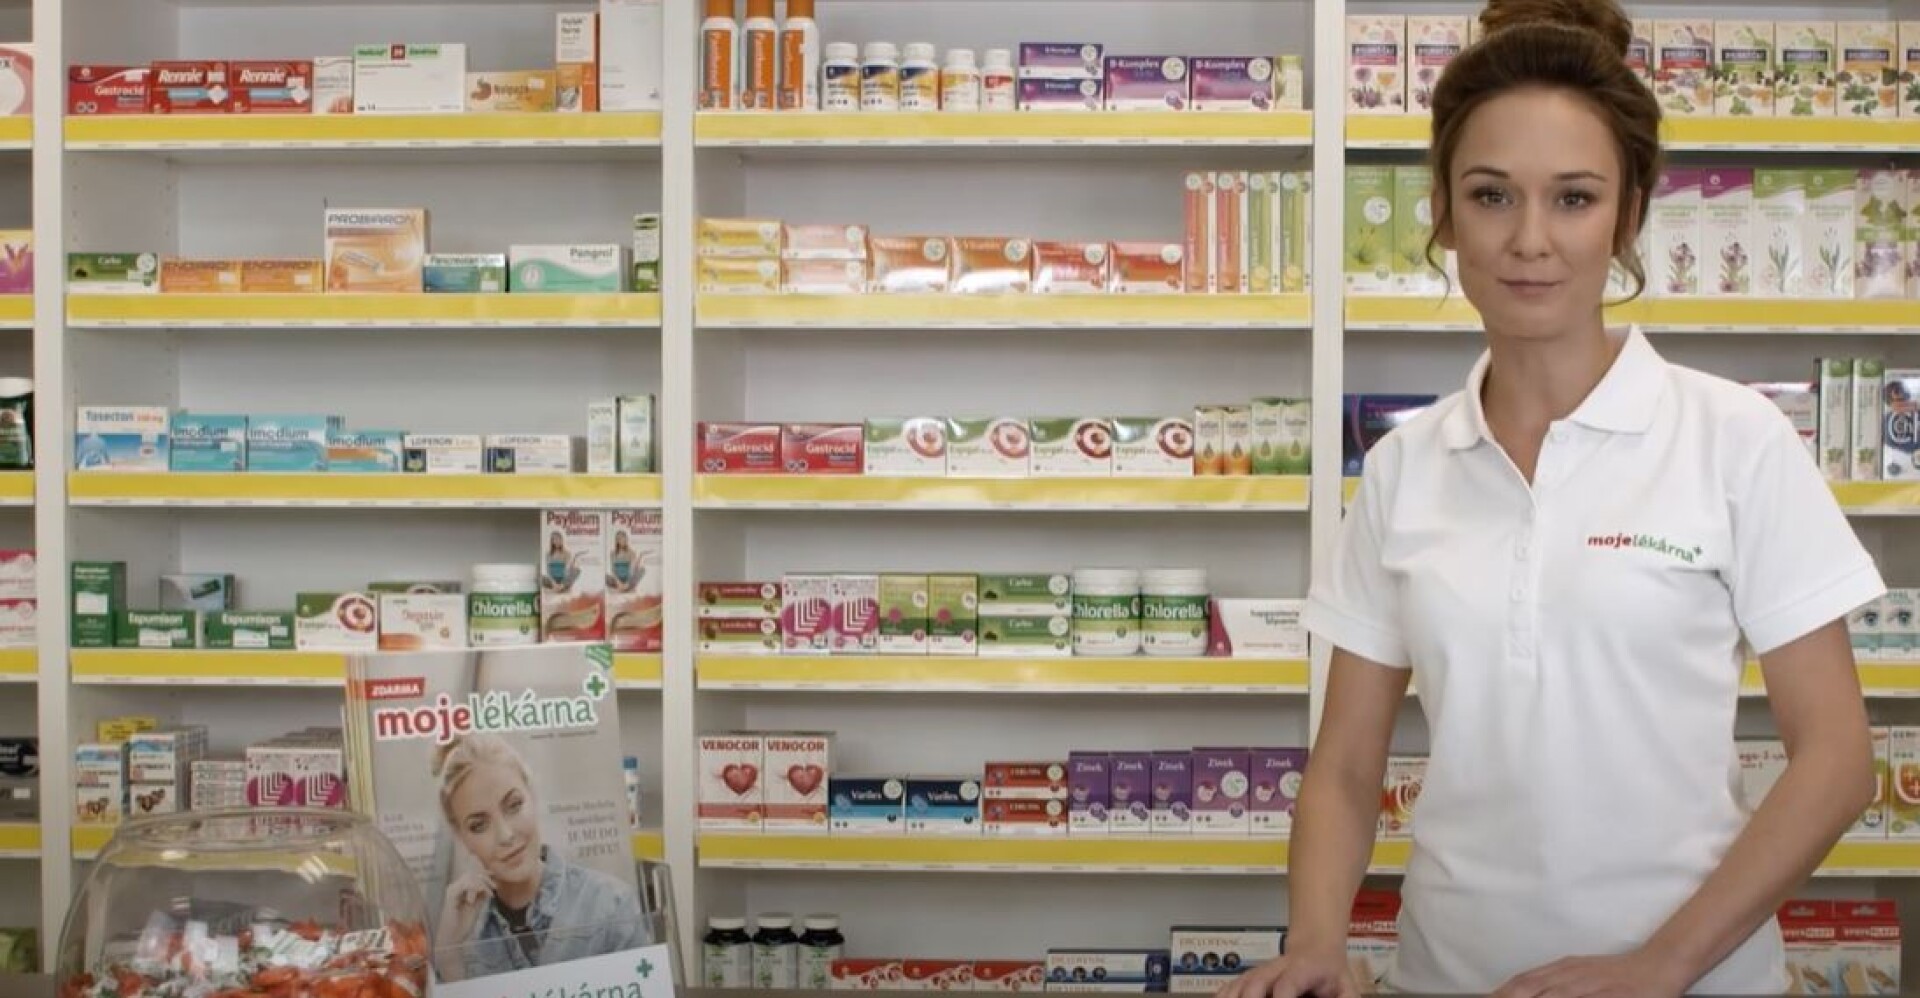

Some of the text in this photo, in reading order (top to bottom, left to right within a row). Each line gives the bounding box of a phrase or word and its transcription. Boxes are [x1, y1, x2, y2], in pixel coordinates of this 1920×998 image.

[158, 69, 203, 85] Rennie
[239, 68, 286, 84] Rennie
[95, 84, 145, 97] Gastrocid
[723, 442, 774, 454] Gastrocid
[806, 442, 857, 454] Gastrocid
[546, 510, 600, 529] Psyllium
[472, 600, 534, 617] Chlorella
[1072, 603, 1130, 619] Chlorella
[1144, 604, 1204, 619] Chlorella
[371, 683, 420, 697] ZDARMA
[377, 690, 594, 741] mojelékárna
[702, 740, 760, 752] VENOCOR
[767, 740, 825, 752] VENOCOR
